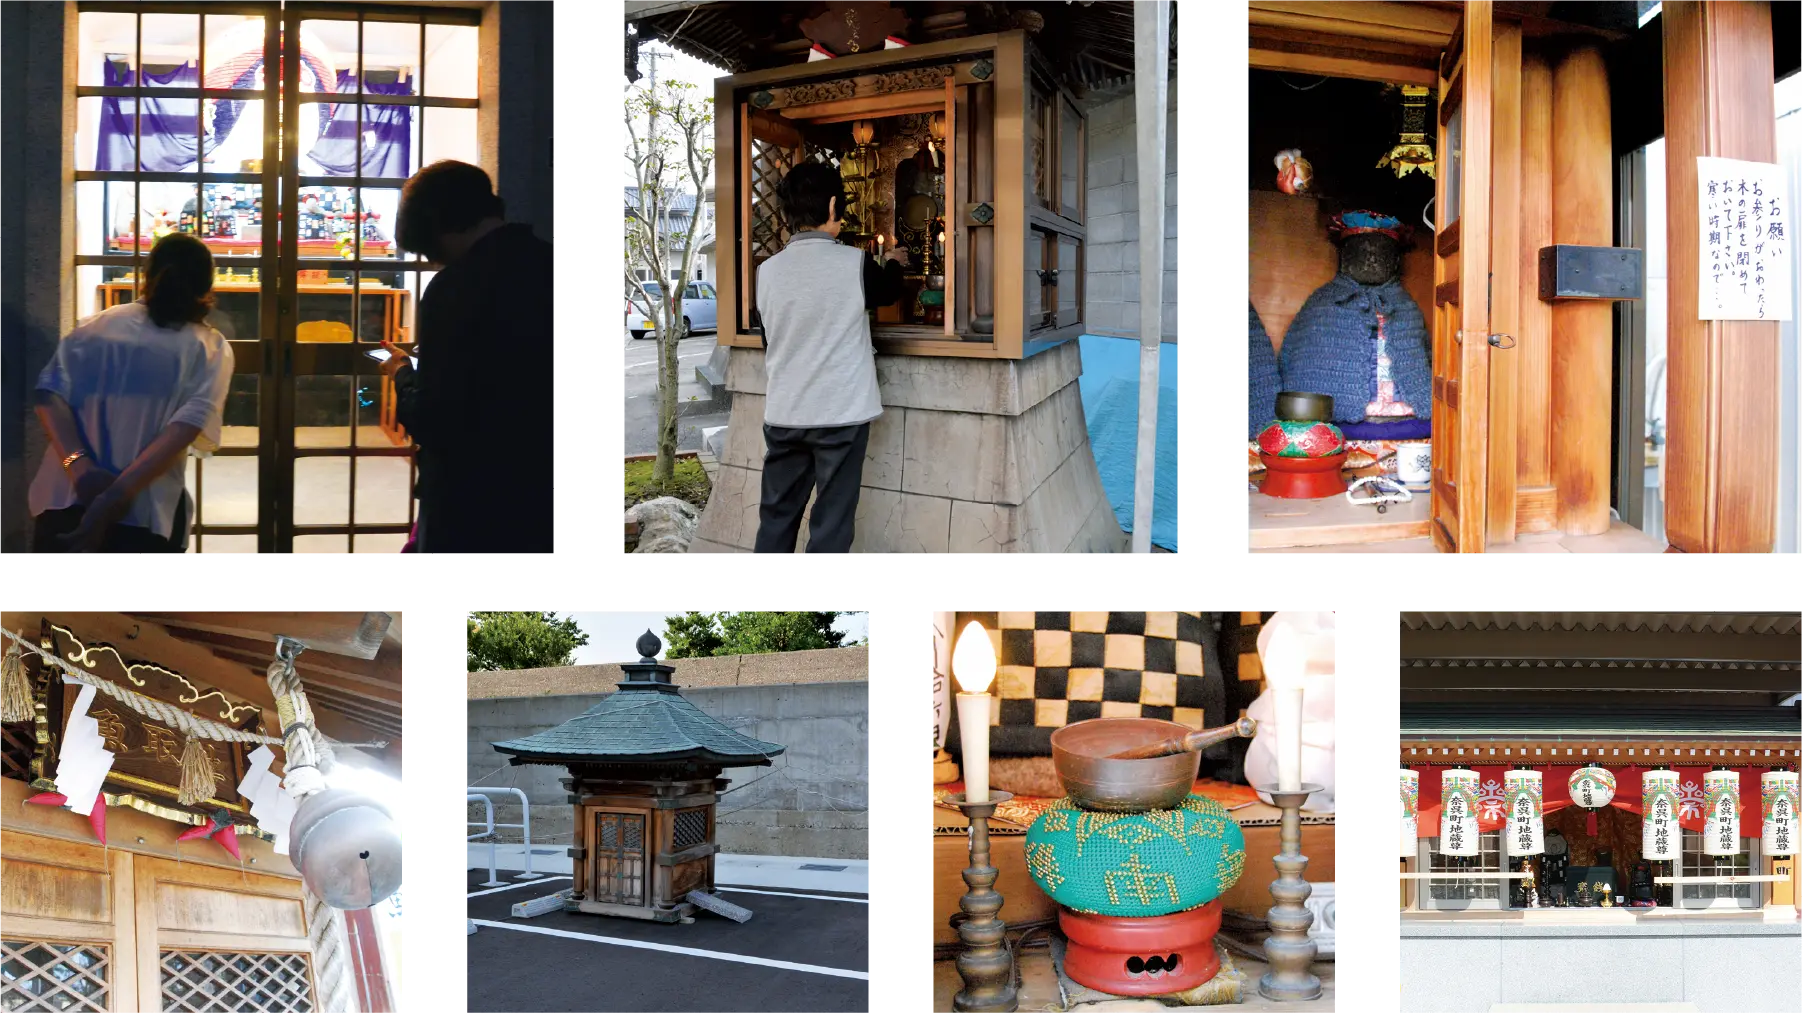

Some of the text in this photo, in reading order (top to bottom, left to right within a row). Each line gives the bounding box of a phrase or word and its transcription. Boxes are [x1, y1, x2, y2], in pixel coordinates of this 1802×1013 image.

[1722, 180, 1736, 276] おいて下さい。
[1735, 179, 1750, 296] 木の扉を閉めて
[1752, 179, 1765, 319] お参りがおわったら
[1767, 198, 1785, 257] お願い
